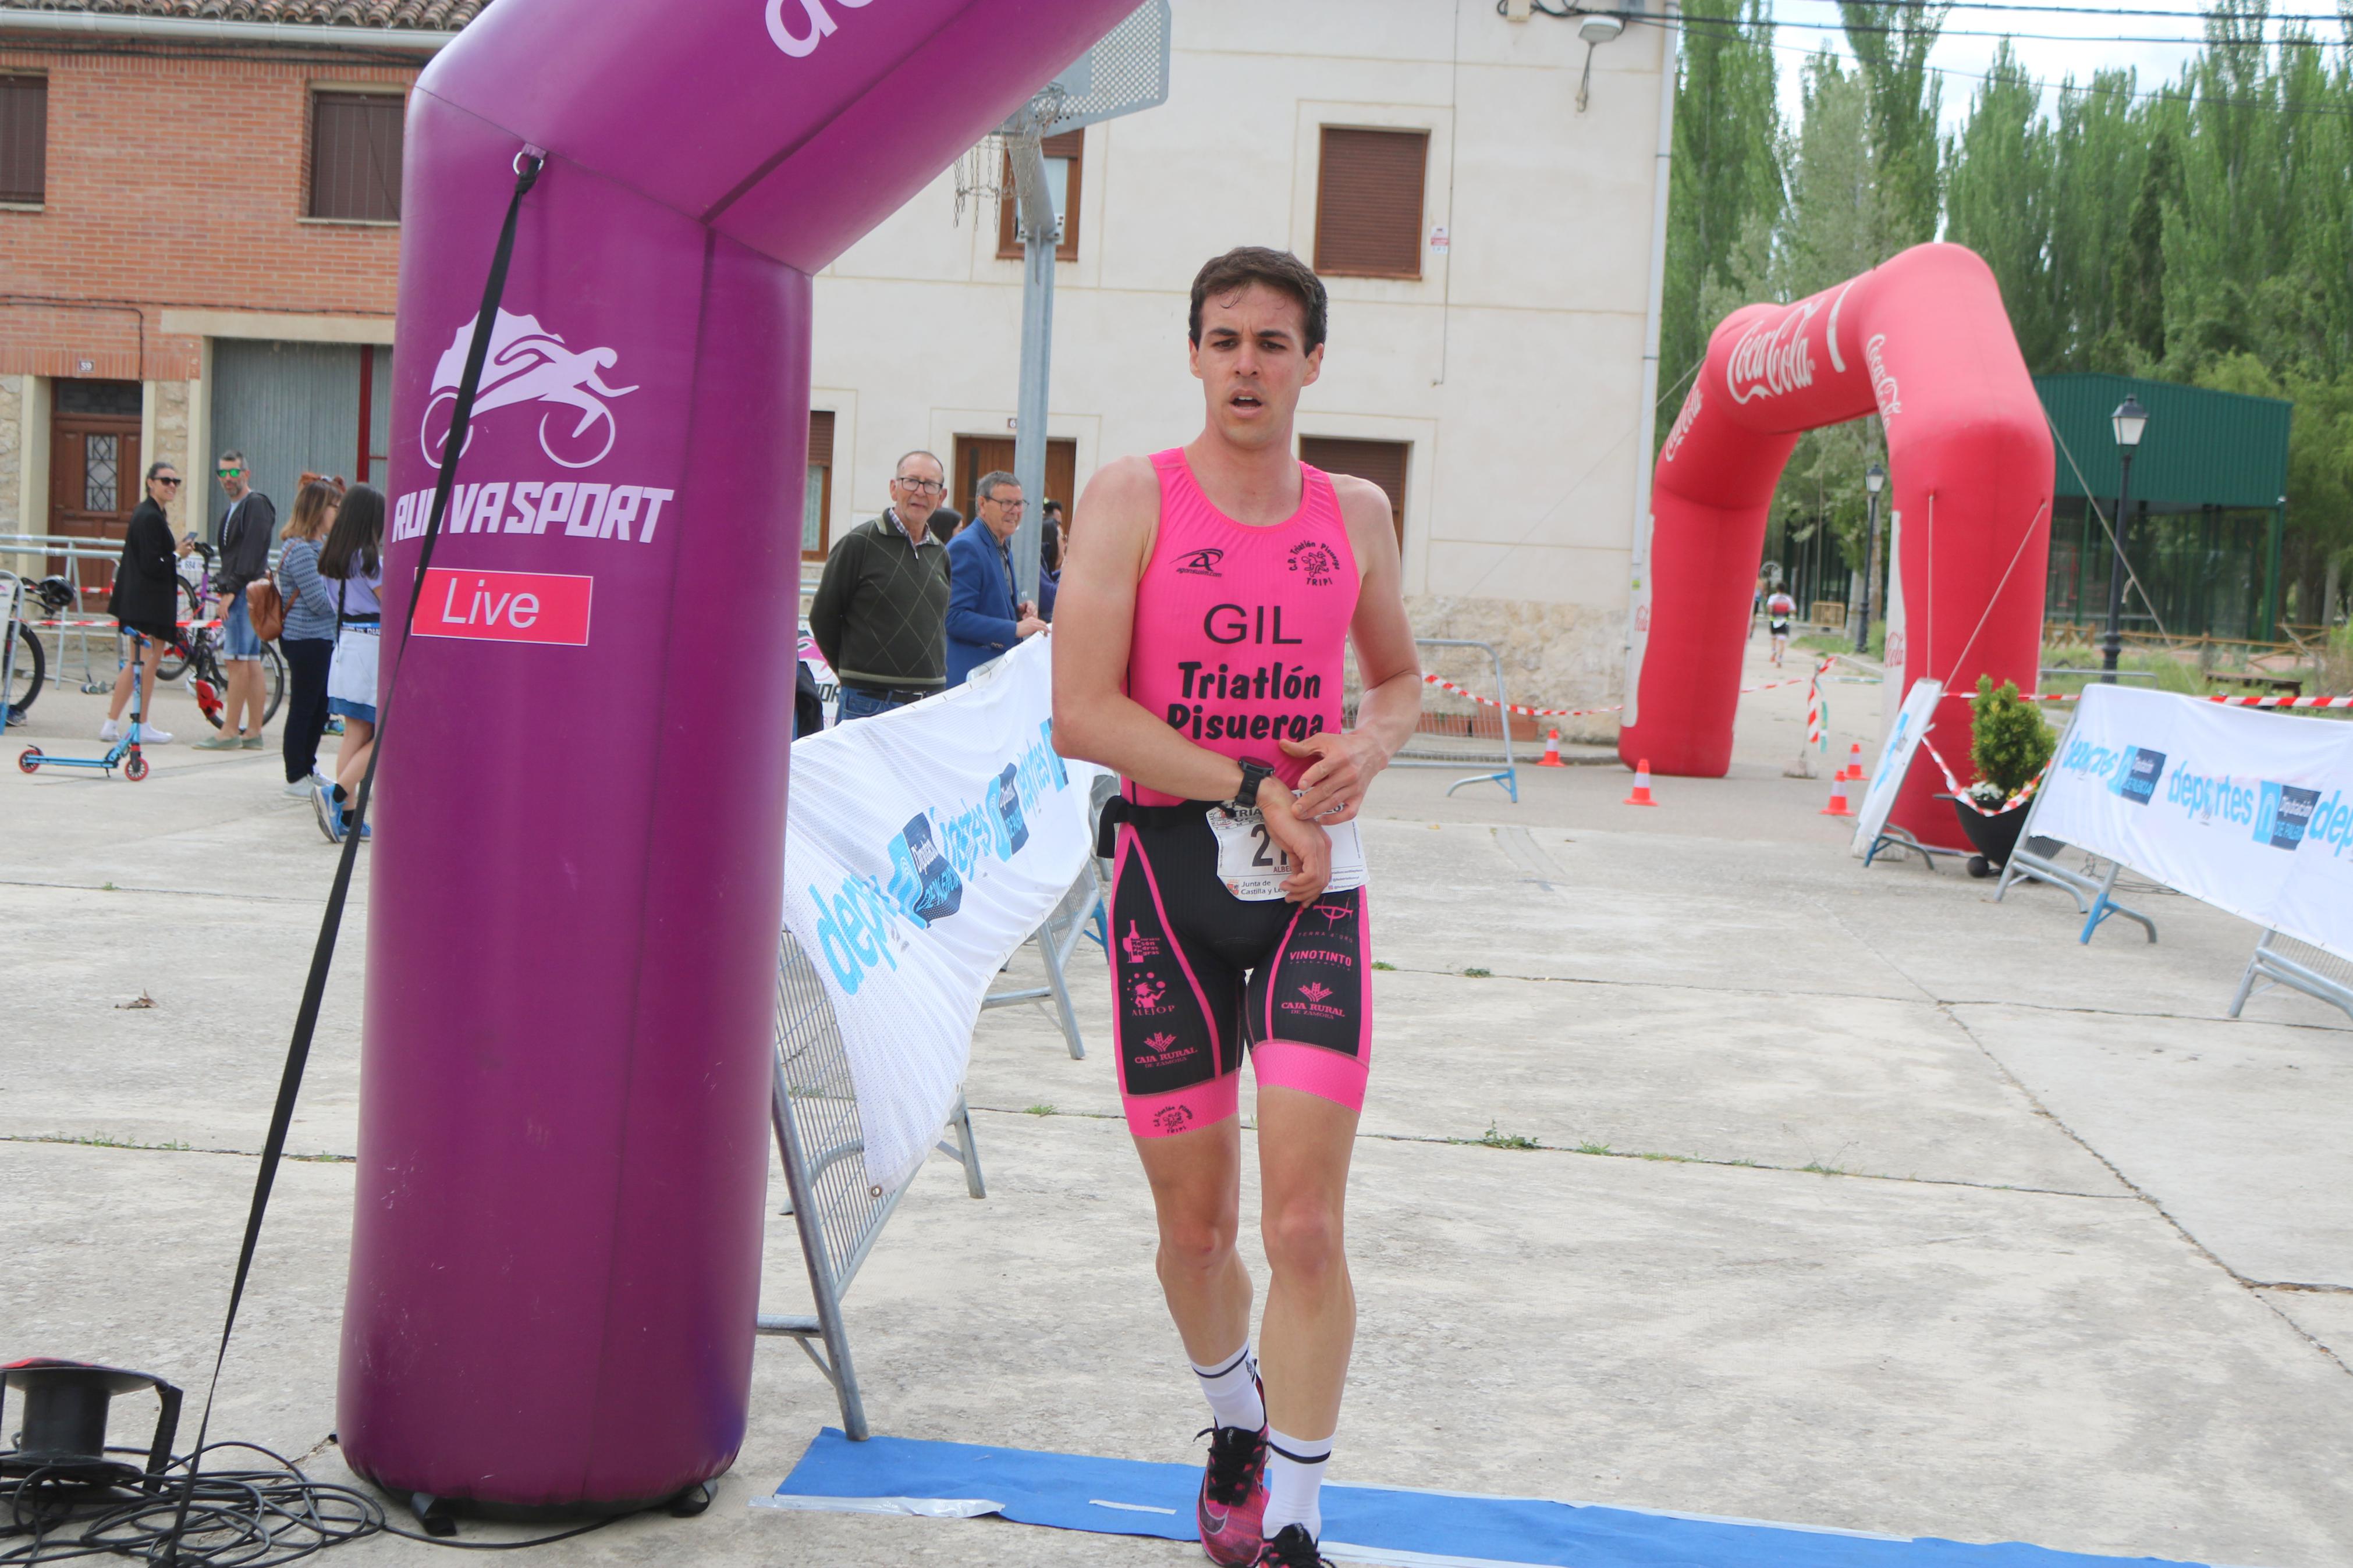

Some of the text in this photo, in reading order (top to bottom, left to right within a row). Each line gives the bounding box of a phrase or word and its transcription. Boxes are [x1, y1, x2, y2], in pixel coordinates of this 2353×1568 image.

[1307, 577, 1333, 586] TRIPI
[442, 578, 540, 628] Live
[1204, 603, 1302, 645] GIL
[1178, 661, 1321, 700] Triatlón
[1167, 703, 1324, 742] Pisuerga
[1290, 950, 1351, 967] VINOTINTO
[1304, 1010, 1334, 1019] ZAMORA
[1309, 1003, 1345, 1017] RURAL
[1135, 1047, 1198, 1064] CAJA RURAL
